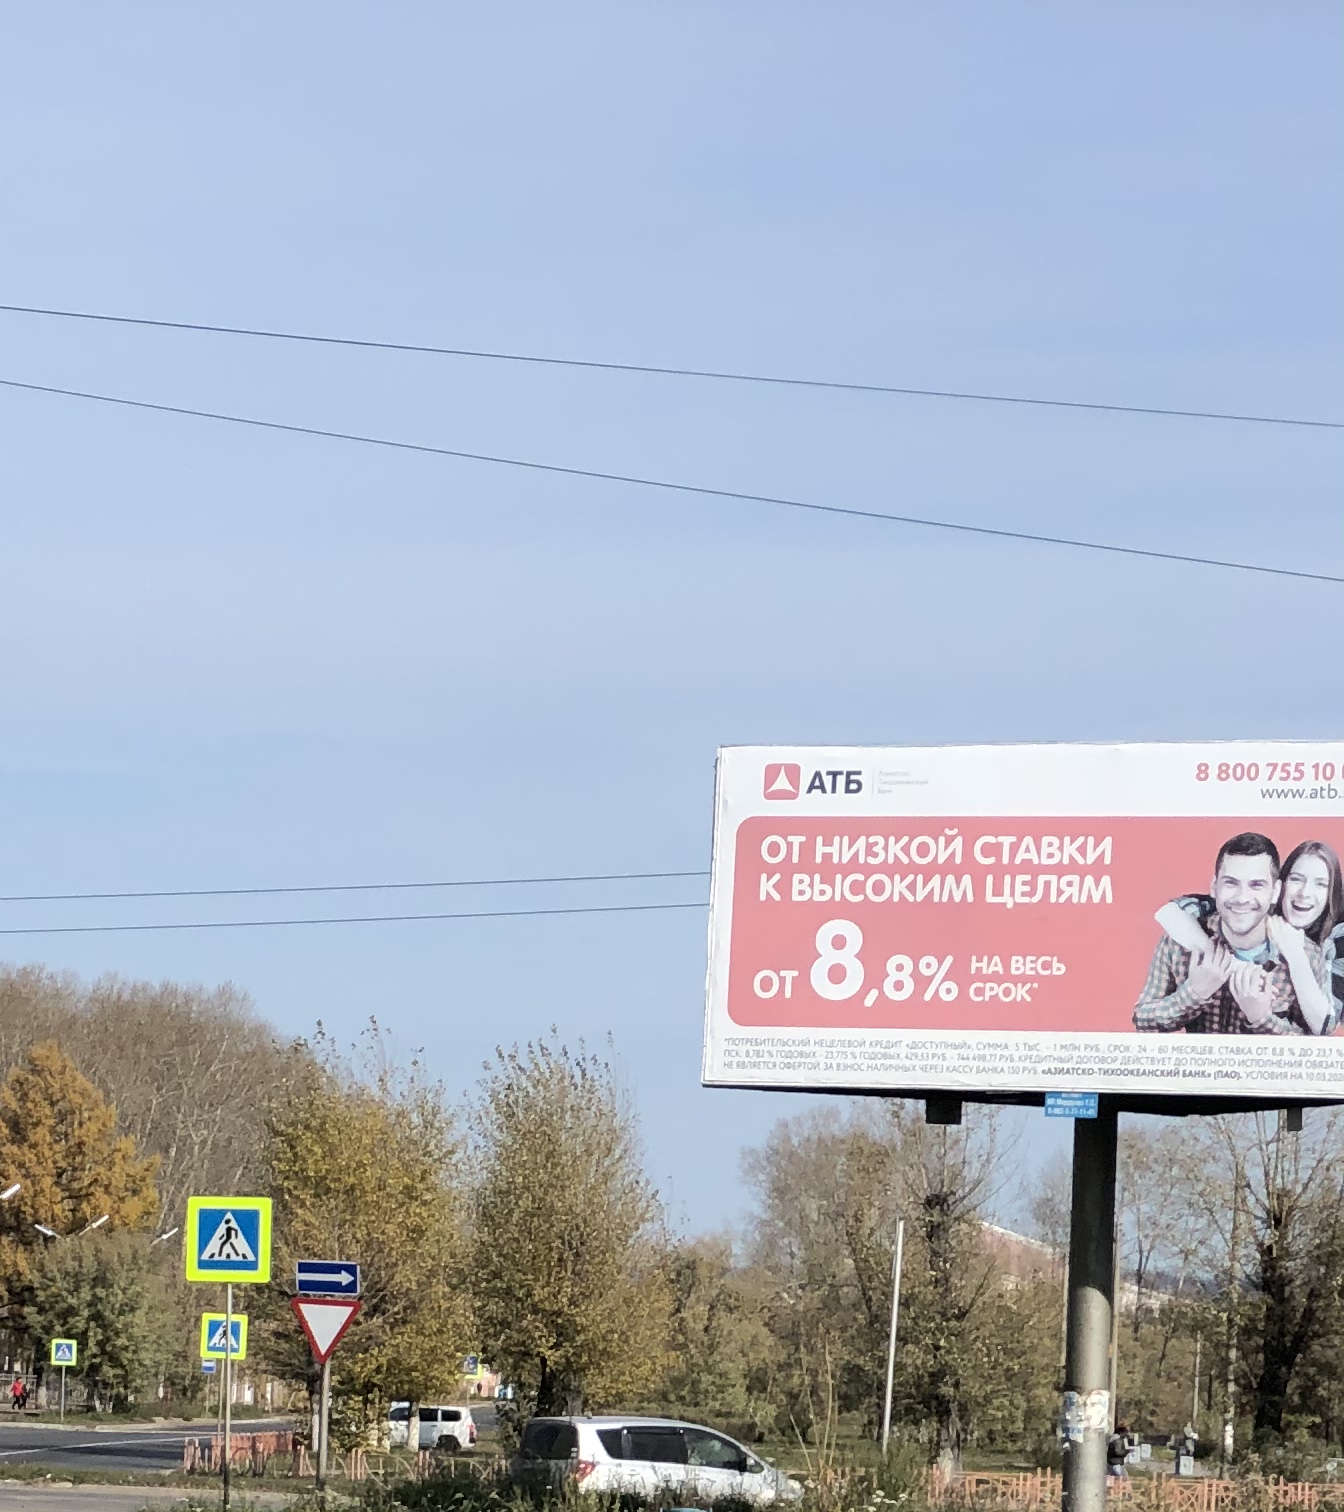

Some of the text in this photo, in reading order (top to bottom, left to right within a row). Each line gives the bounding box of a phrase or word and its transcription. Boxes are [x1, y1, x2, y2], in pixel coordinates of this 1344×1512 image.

[806, 770, 863, 795] АТБ
[1195, 762, 1209, 782] 8
[1217, 762, 1260, 782] 800
[1266, 762, 1305, 782] 755
[1312, 762, 1335, 781] 10
[1260, 784, 1344, 799] www.atb.
[760, 828, 1113, 866] ОТ НИЗКОЙ СТАВКИ
[760, 873, 1113, 908] К ВЫСОКИМ ЦЕЛЯМ
[970, 956, 1066, 977] НА ВЕСЬ
[753, 969, 799, 999] ОТ
